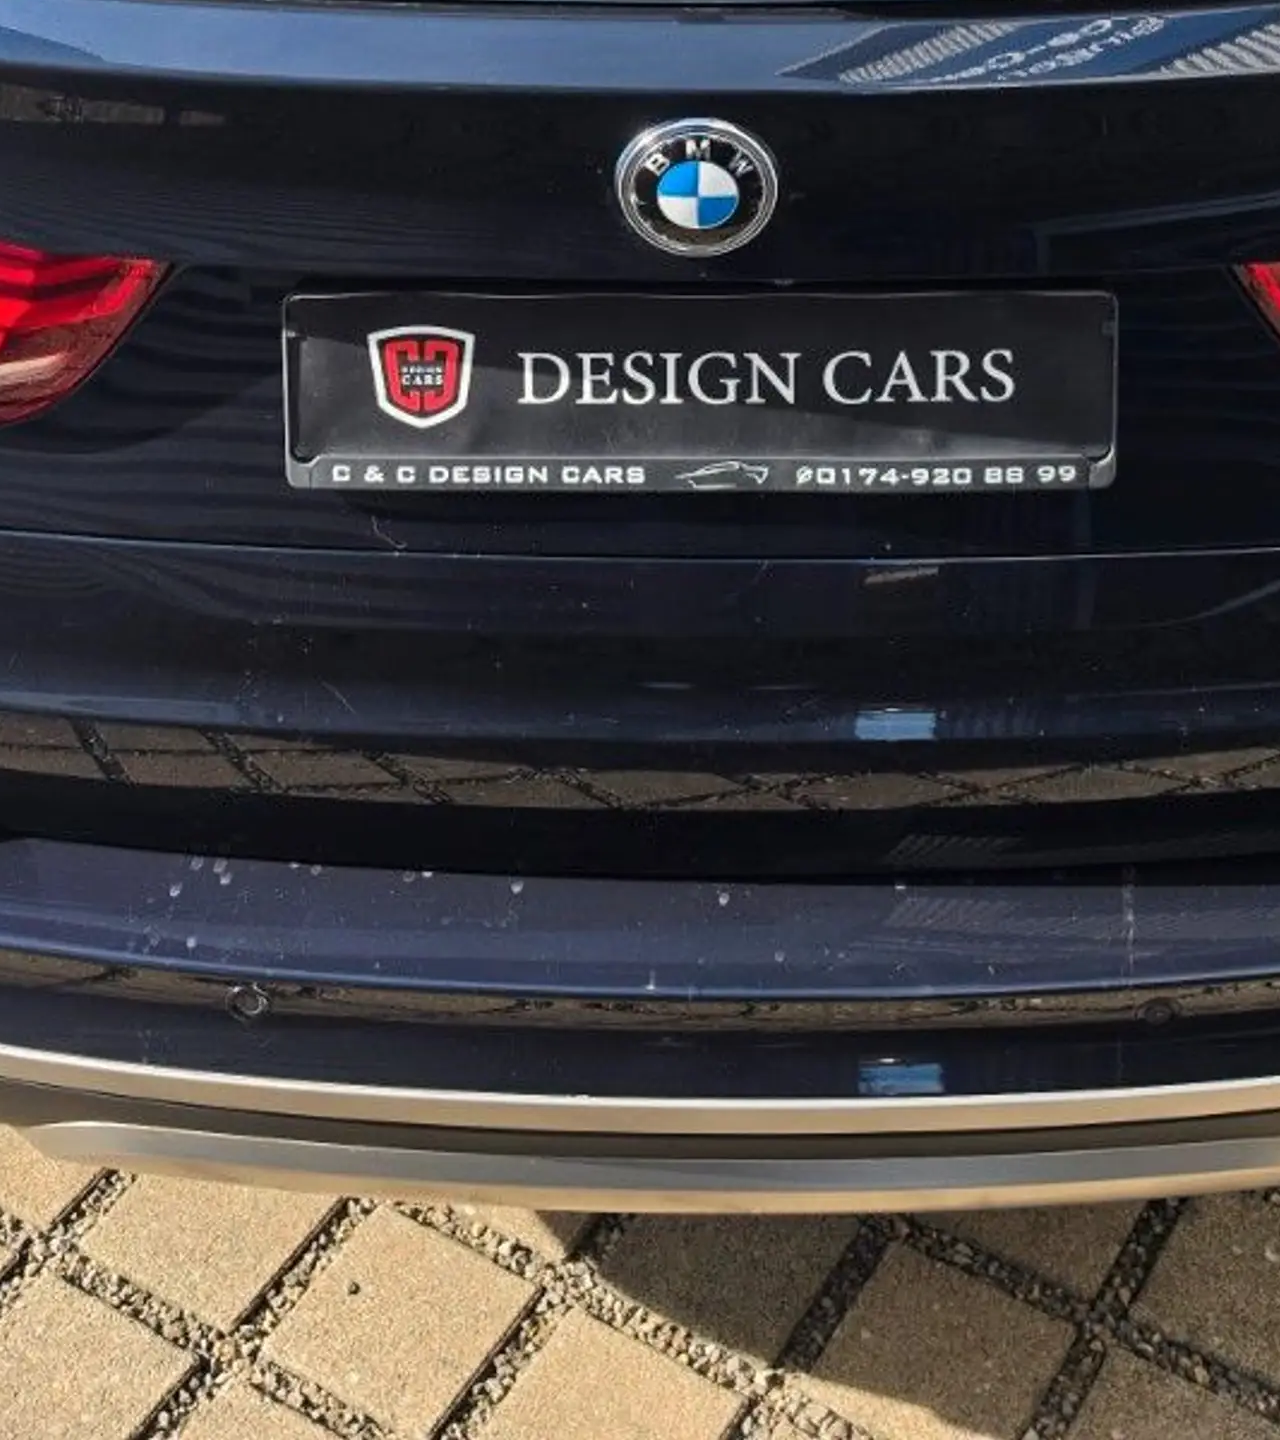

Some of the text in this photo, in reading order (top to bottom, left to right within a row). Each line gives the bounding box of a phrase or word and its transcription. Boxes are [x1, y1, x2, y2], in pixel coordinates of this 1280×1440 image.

[644, 138, 754, 179] BMW
[401, 374, 444, 386] CARS
[517, 349, 1016, 406] DESIGN CARS
[331, 465, 352, 483] C
[363, 465, 385, 483] &
[397, 465, 416, 483] C
[428, 465, 549, 484] DESIGN
[560, 466, 646, 485] CARS
[984, 466, 1025, 485] 88
[1036, 464, 1077, 483] 99
